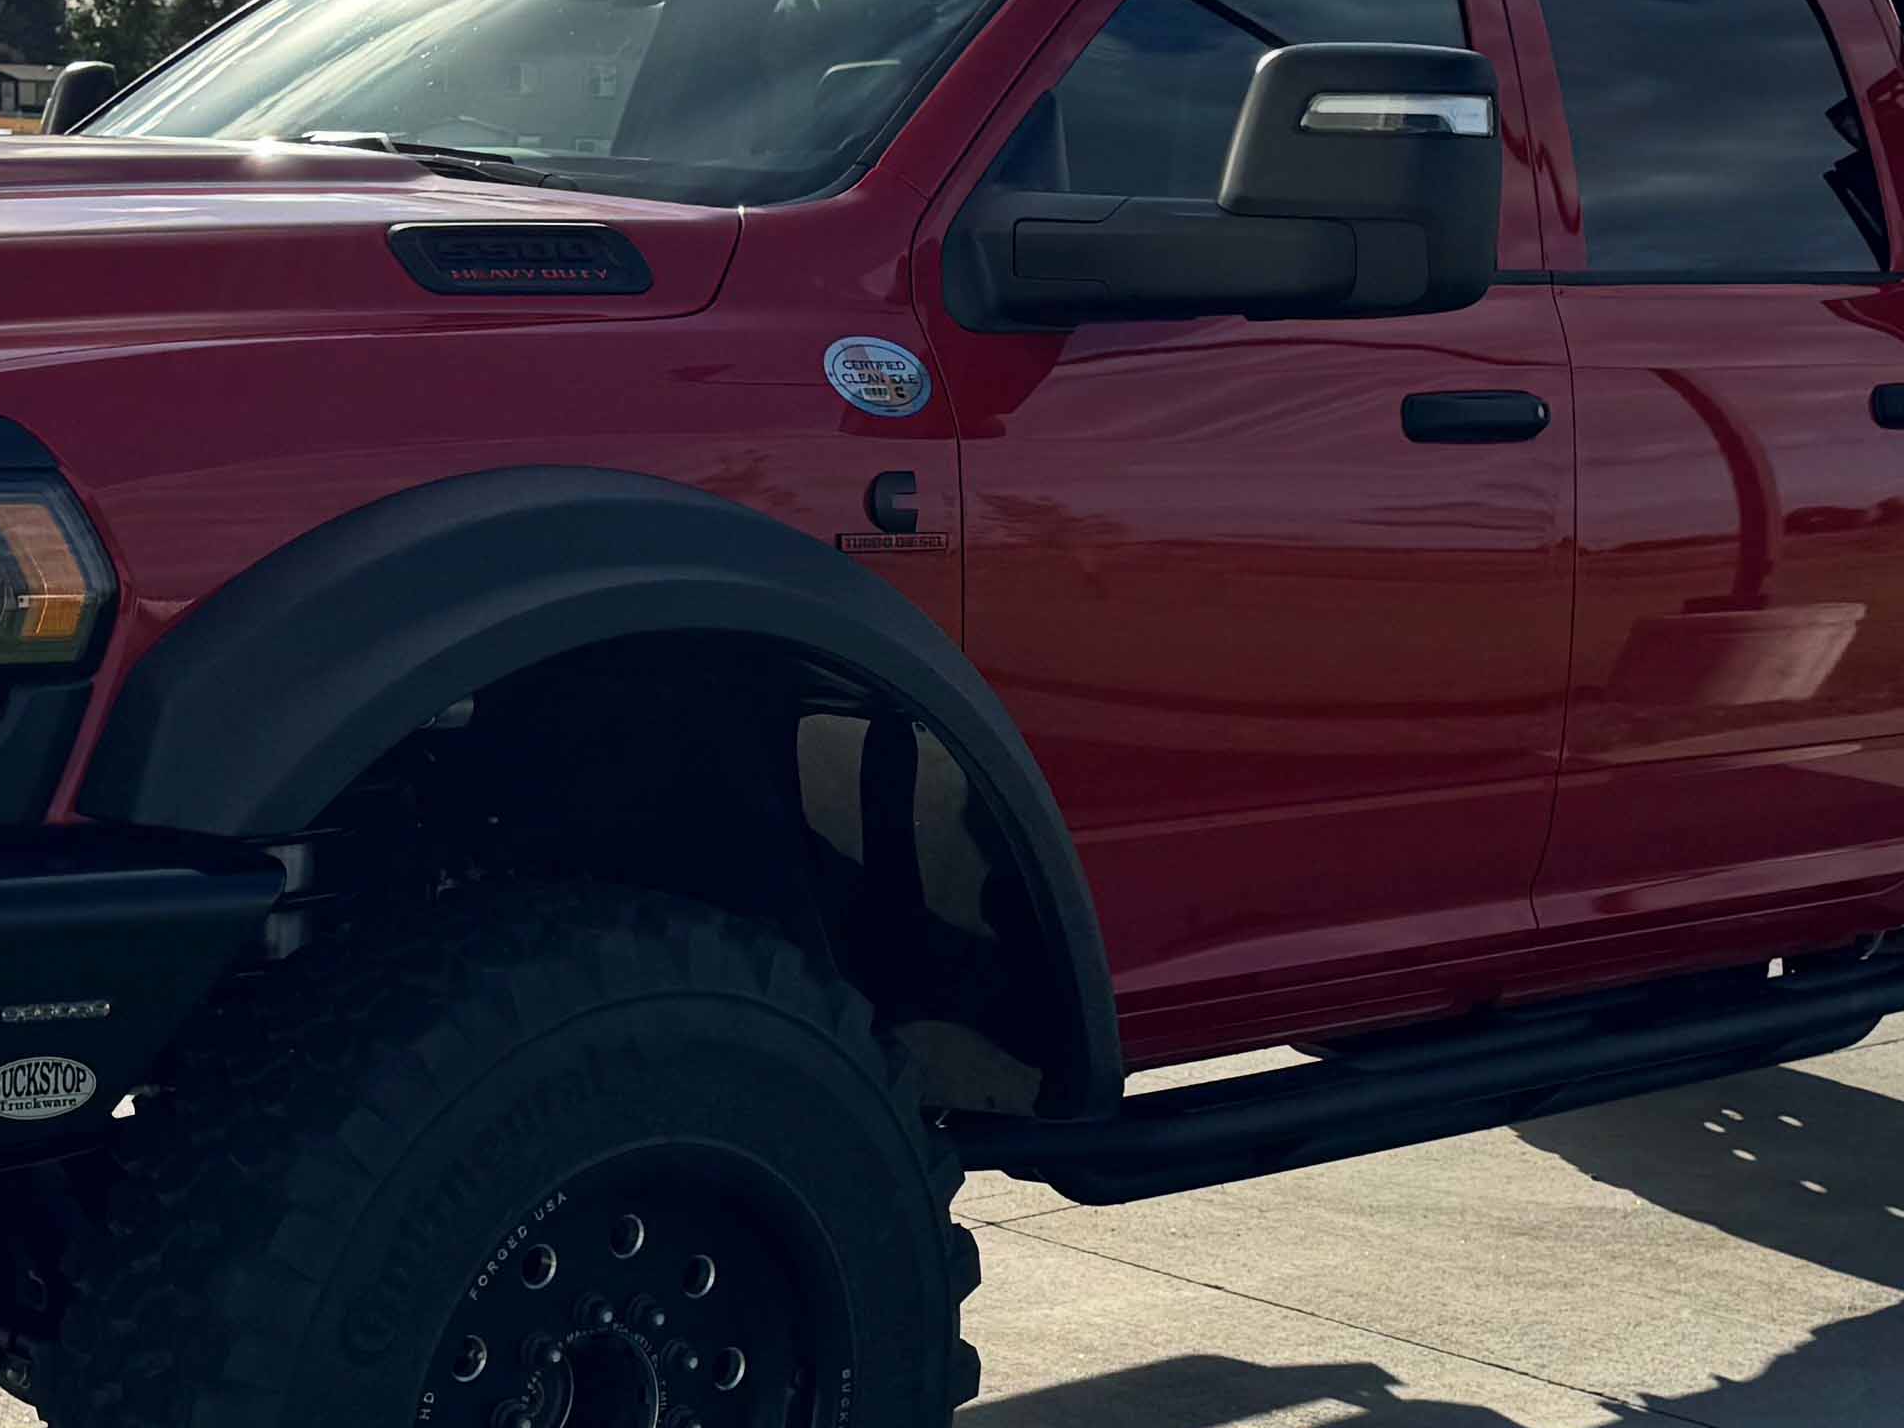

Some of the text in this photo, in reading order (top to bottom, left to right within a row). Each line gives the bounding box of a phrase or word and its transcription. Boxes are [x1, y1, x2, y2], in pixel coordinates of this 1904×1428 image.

[450, 268, 608, 281] HEAVY DUTY
[841, 359, 907, 372] CERTIFIED
[841, 372, 886, 385] CLEAN
[467, 1189, 570, 1302] FORGED USA
[416, 1388, 440, 1423] HD
